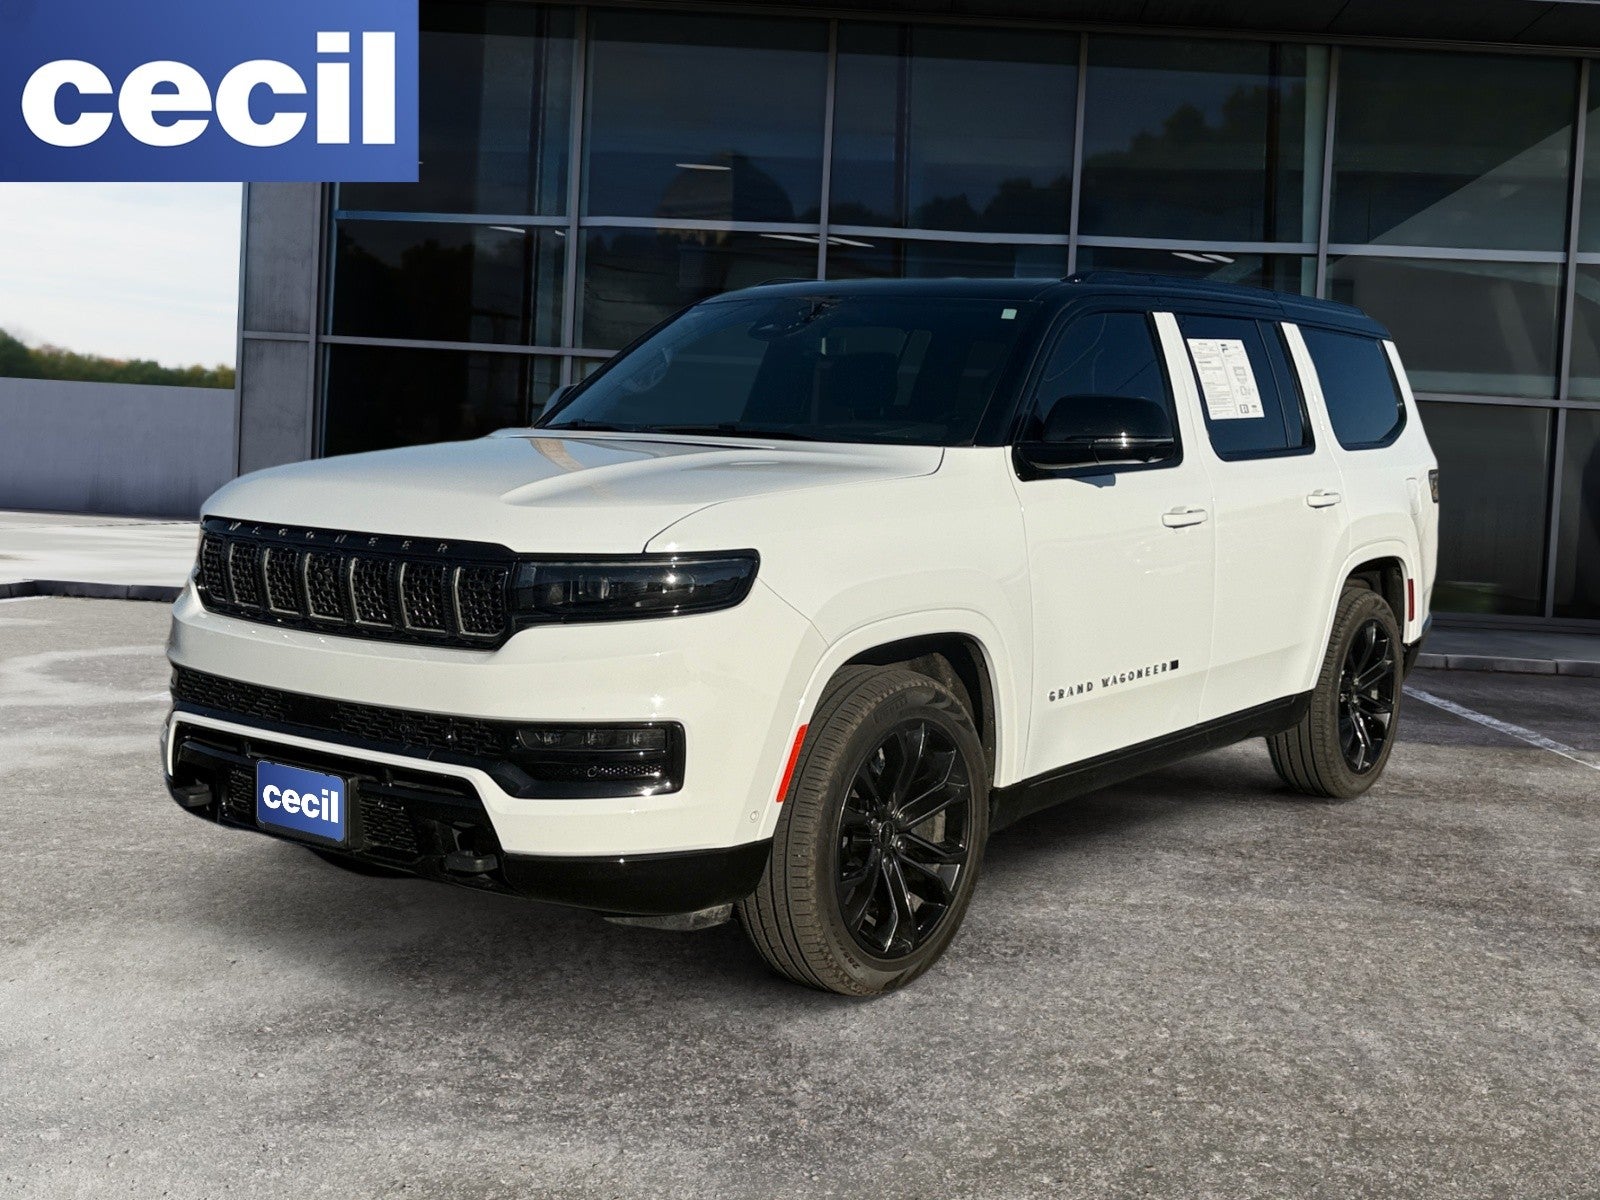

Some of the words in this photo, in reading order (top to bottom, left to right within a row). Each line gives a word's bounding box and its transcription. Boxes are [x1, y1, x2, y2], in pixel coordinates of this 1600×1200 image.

[1048, 681, 1094, 702] GRAND
[1101, 661, 1168, 688] WAGONEER
[262, 784, 339, 824] cecil
